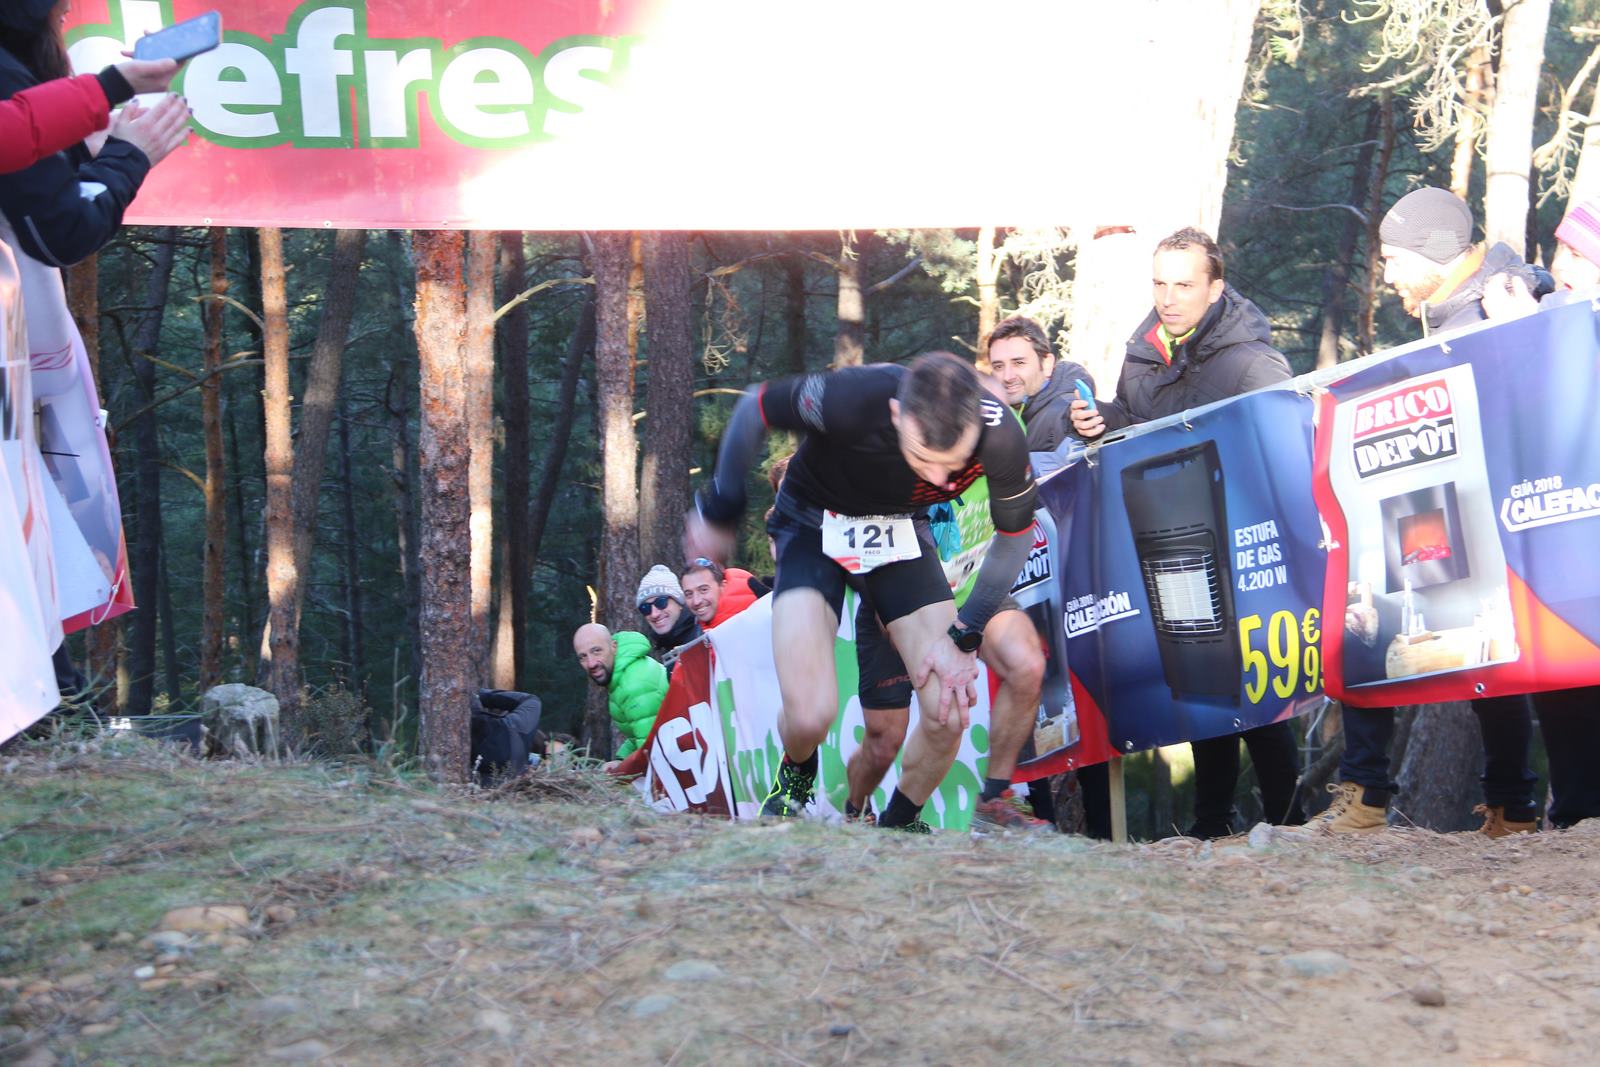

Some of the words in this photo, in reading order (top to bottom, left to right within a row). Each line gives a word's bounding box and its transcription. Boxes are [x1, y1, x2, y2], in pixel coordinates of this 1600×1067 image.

[1354, 386, 1450, 434] BRICO
[1354, 418, 1454, 473] DEPÔT
[844, 525, 895, 549] 121
[1234, 519, 1279, 548] ESTUFA
[1237, 551, 1256, 570] DE
[1257, 542, 1282, 567] GAS
[1237, 568, 1274, 592] 4.200
[1275, 564, 1288, 585] W
